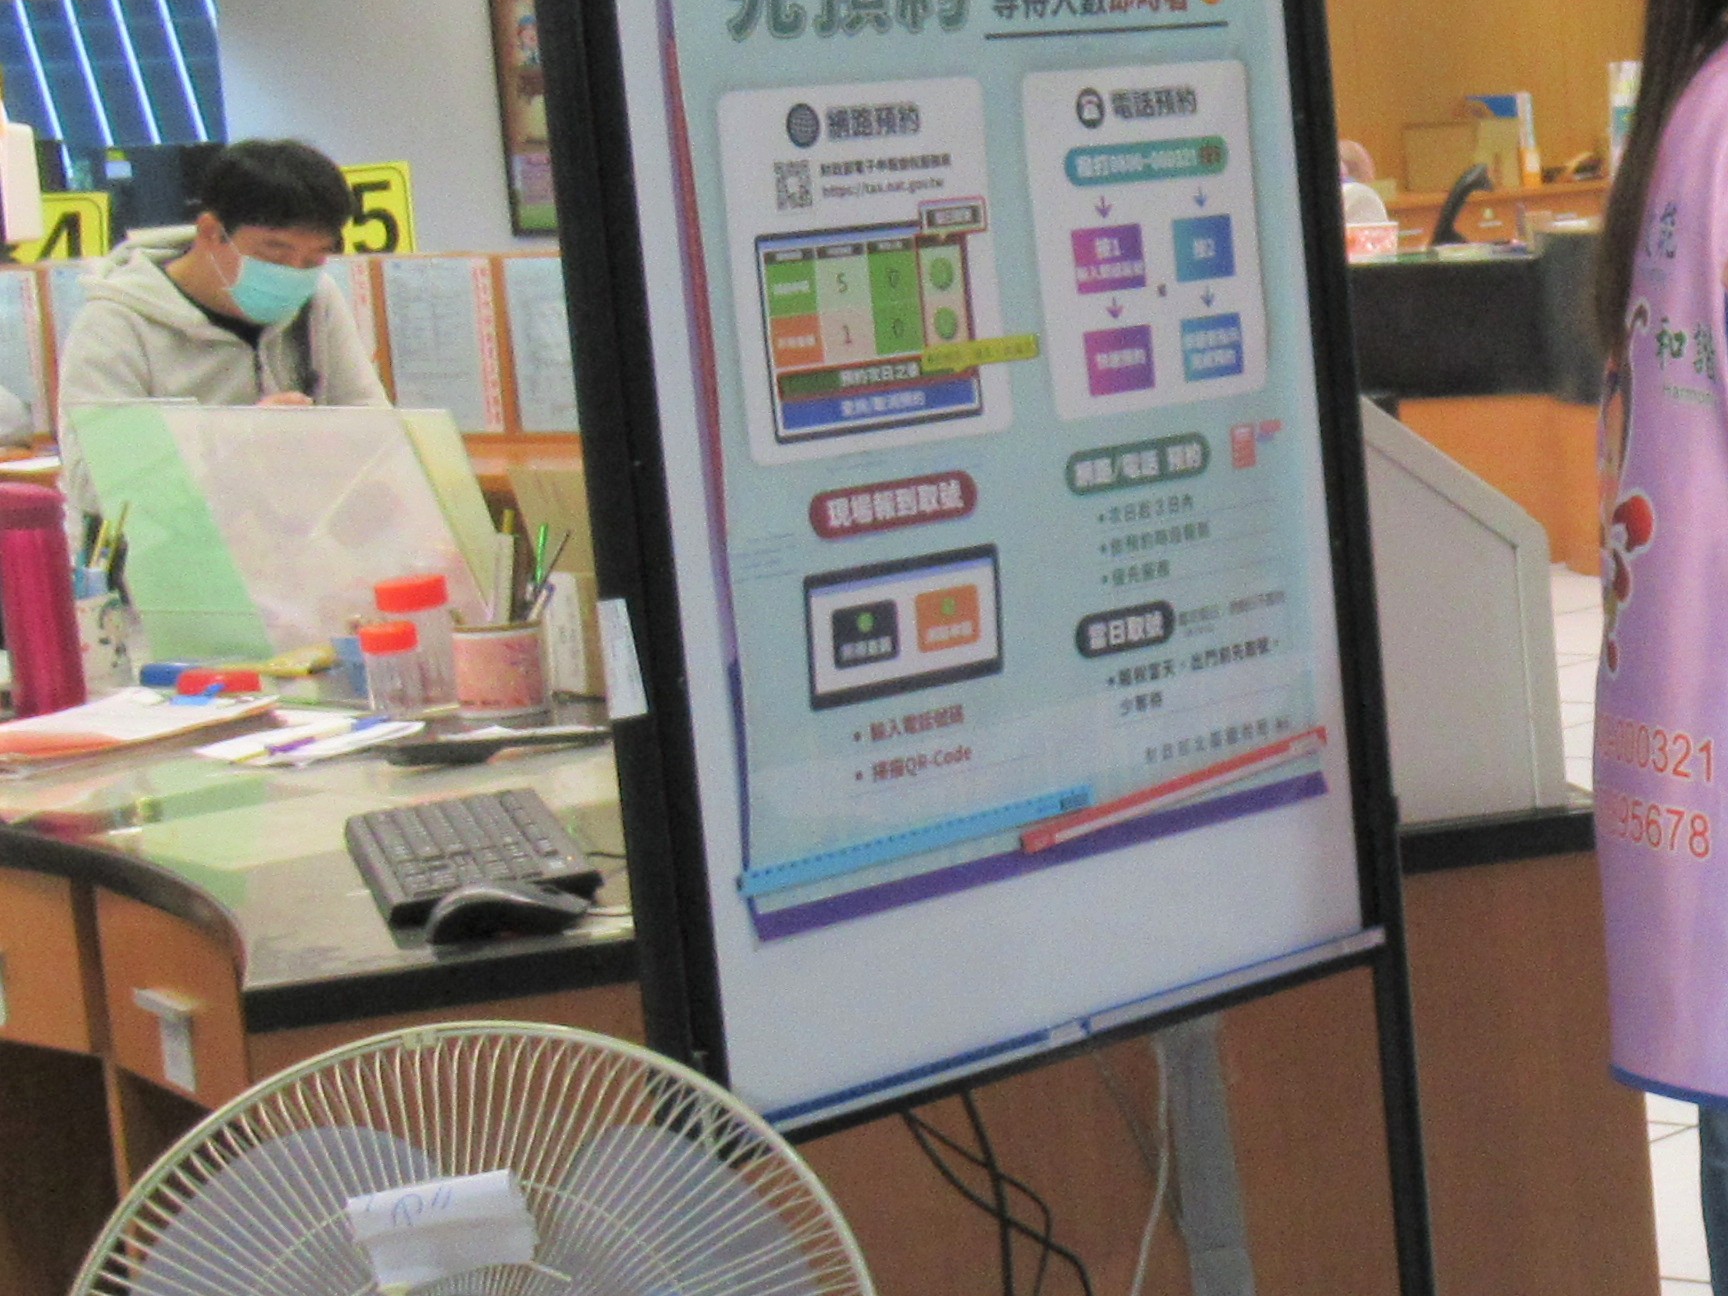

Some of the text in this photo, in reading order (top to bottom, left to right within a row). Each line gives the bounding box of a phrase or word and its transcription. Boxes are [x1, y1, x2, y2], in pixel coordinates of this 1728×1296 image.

[38, 211, 81, 258] 4
[351, 180, 399, 253] 5
[836, 272, 849, 295] 5
[842, 324, 852, 345] 1
[1087, 610, 1165, 650] 當日取號
